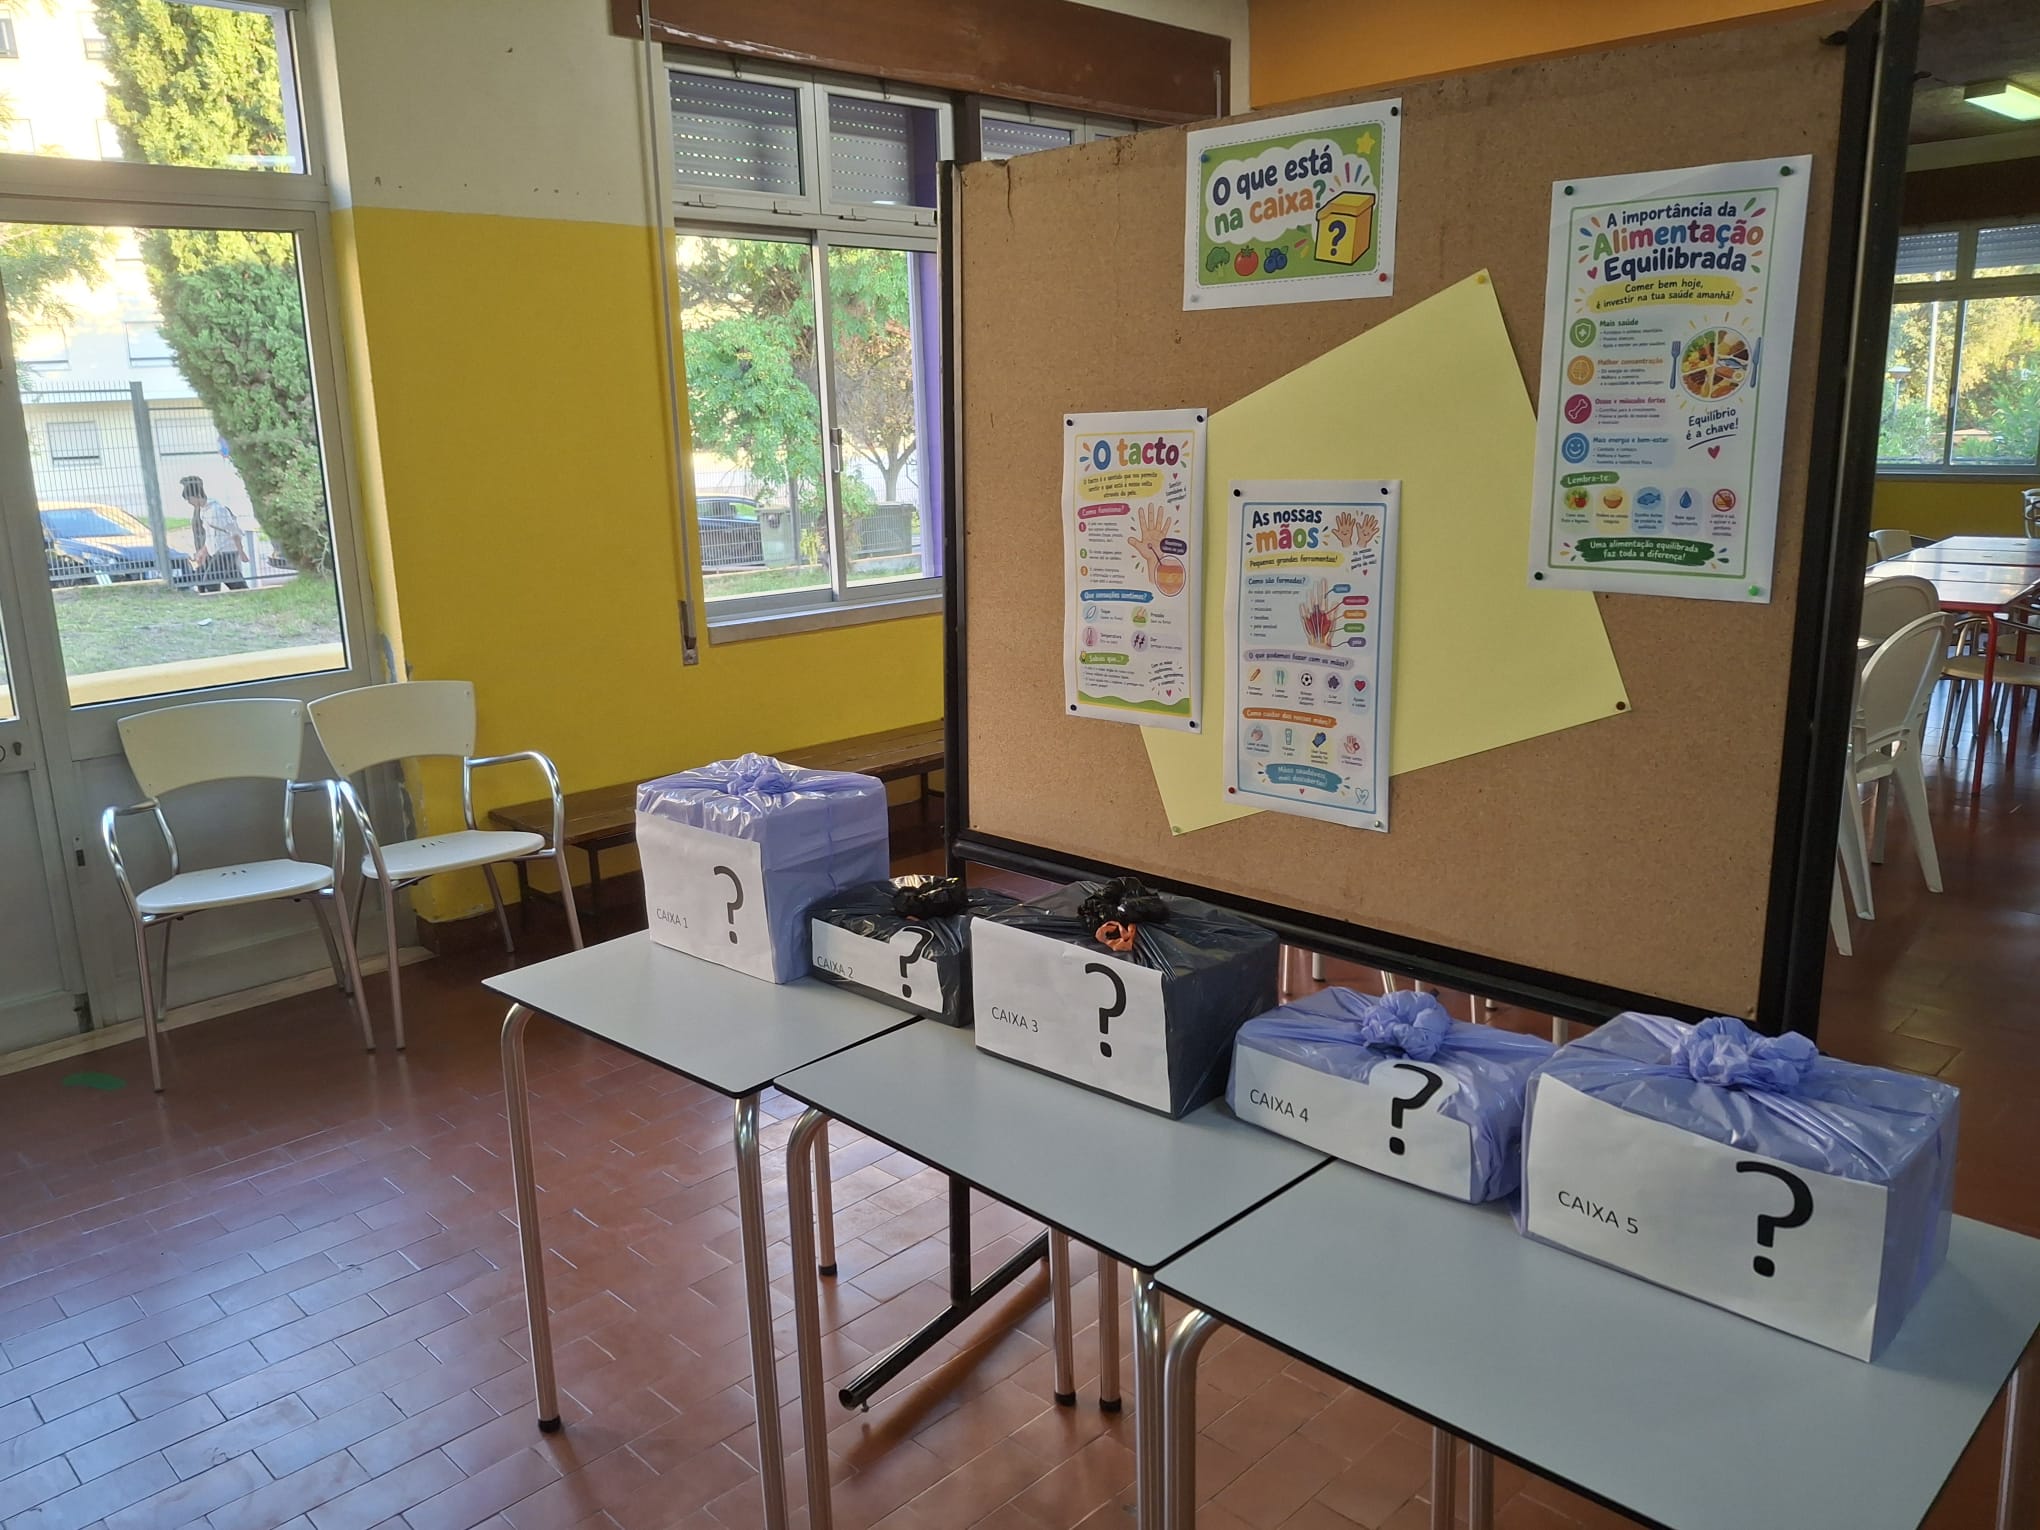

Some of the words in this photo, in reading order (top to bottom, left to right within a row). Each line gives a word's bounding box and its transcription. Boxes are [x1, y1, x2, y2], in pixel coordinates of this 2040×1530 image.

[1213, 176, 1231, 206] O
[1237, 164, 1278, 200] que
[1284, 144, 1333, 181] está
[1214, 207, 1244, 236] na
[1249, 179, 1326, 224] caixa?
[1606, 213, 1618, 229] A
[1622, 202, 1714, 227] importância
[1717, 201, 1737, 217] da
[1593, 219, 1764, 261] Alimentação
[1604, 246, 1747, 282] Equilibrada
[1603, 294, 1634, 308] investir
[1637, 294, 1648, 302] na
[1651, 291, 1666, 300] tua
[1668, 290, 1694, 300] saúde
[1696, 290, 1735, 300] amanhã!
[1625, 279, 1654, 293] Comer
[1658, 279, 1678, 290] bem
[1681, 277, 1704, 290] hoje,
[1599, 319, 1615, 328] Mais
[1686, 430, 1692, 441] é
[1696, 430, 1702, 438] a
[1705, 417, 1739, 435] chave!
[1688, 407, 1736, 427] Equilíbrio
[1093, 440, 1111, 470] O
[1116, 437, 1179, 466] tacto
[1252, 510, 1270, 528] As
[1273, 509, 1323, 524] nossas
[1255, 524, 1319, 553] mãos
[1590, 541, 1607, 549] Uma
[1609, 540, 1654, 551] alimentação
[1656, 541, 1699, 554] equilibrada
[1619, 550, 1638, 558] toda
[1248, 577, 1264, 586] Como
[656, 907, 681, 928] CAIXA
[683, 916, 689, 929] 1
[713, 865, 744, 945] ?
[816, 955, 846, 976] CAIXA
[847, 965, 855, 979] 2
[899, 927, 933, 999] ?
[991, 1006, 1029, 1030] CAIXA
[1031, 1019, 1039, 1034] 3
[1085, 962, 1127, 1059] ?
[1249, 1088, 1295, 1118] CAIXA
[1298, 1107, 1309, 1123] 4
[1389, 1063, 1443, 1156] ?
[1557, 1190, 1620, 1229] CAIXA
[1627, 1217, 1639, 1235] 5
[1736, 1161, 1814, 1279] ?
